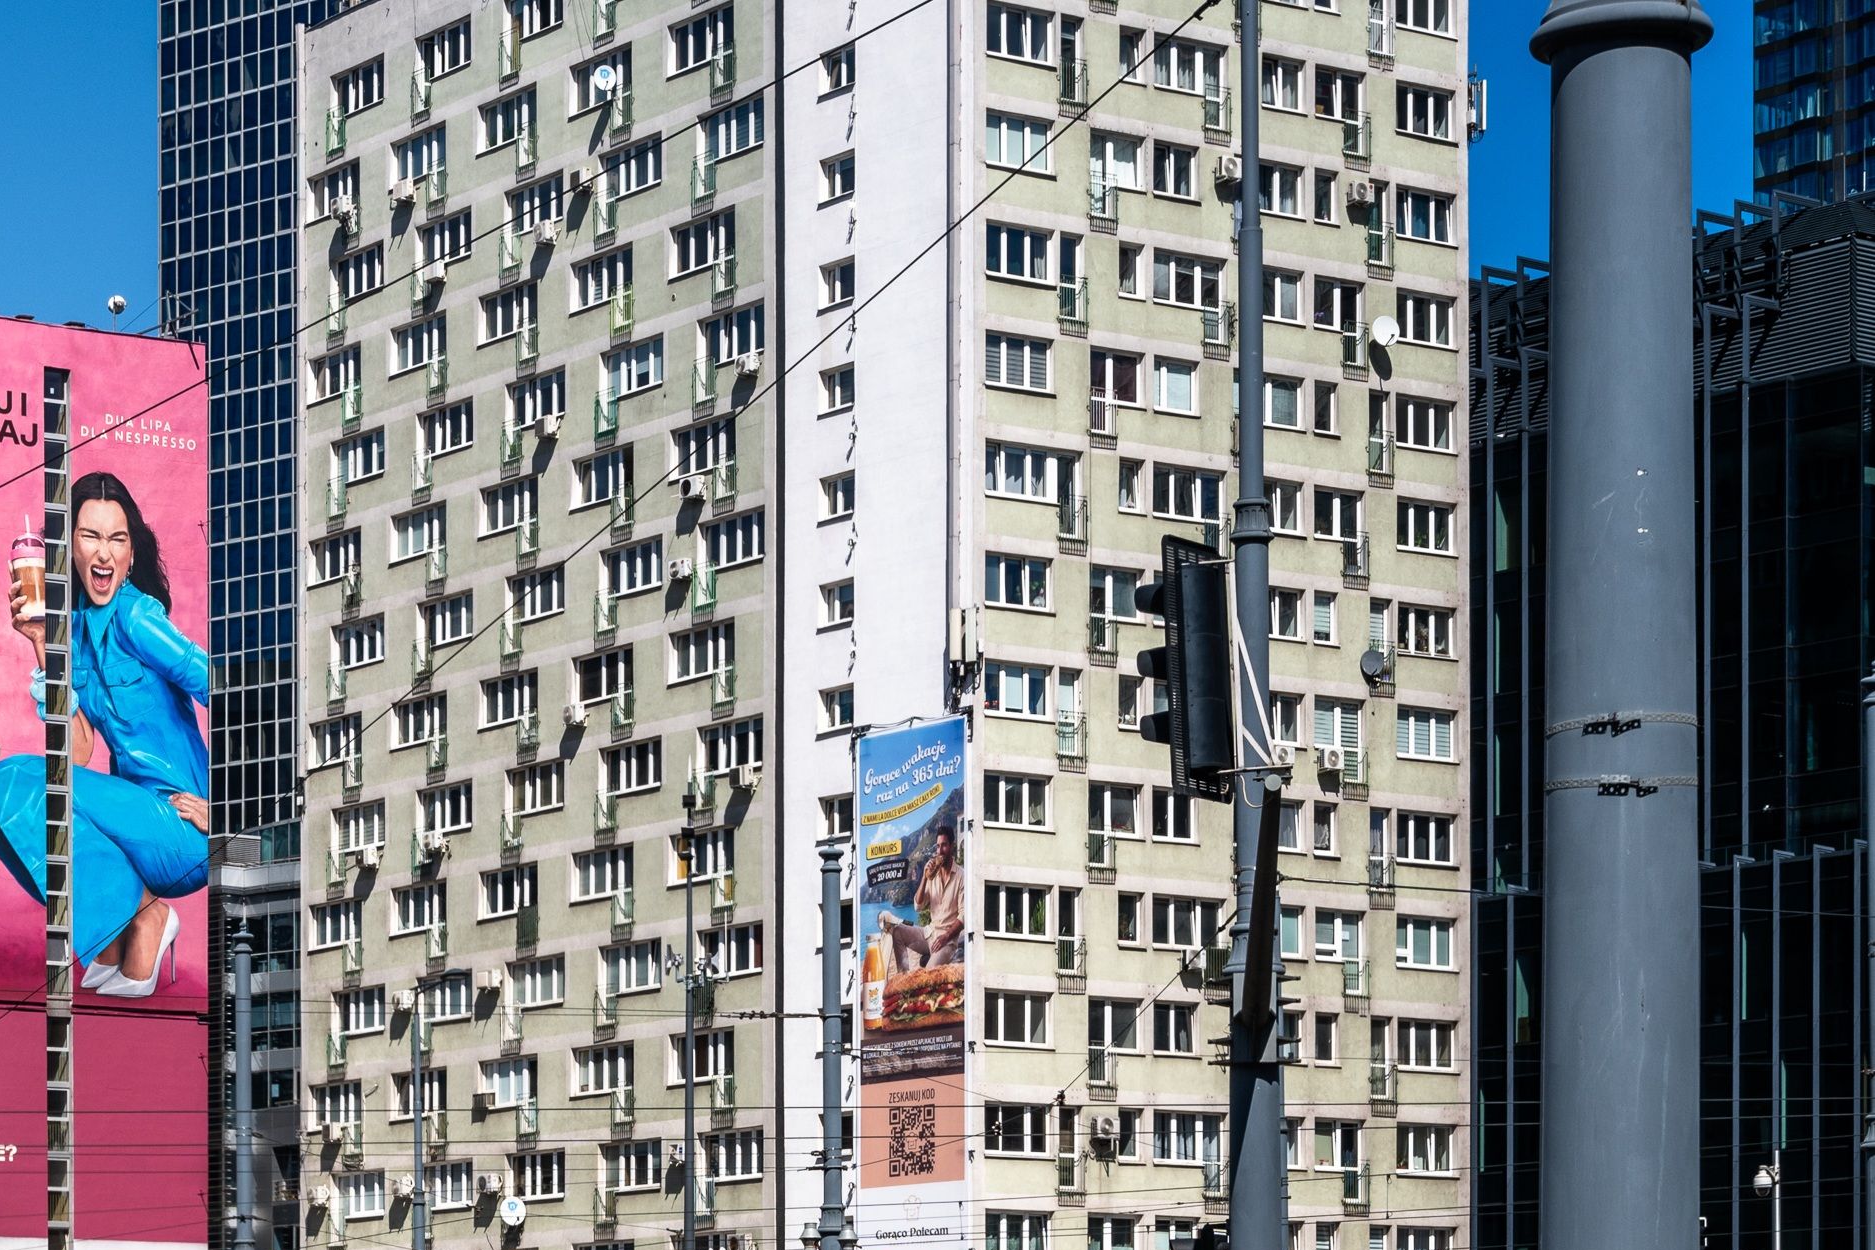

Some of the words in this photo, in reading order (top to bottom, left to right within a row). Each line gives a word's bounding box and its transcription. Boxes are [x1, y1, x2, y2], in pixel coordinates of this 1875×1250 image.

[21, 393, 27, 416] I
[105, 414, 135, 429] DUA
[141, 417, 172, 433] LIPA
[80, 426, 107, 440] DLA
[115, 430, 197, 451] NESPRESSO
[864, 766, 900, 795] Gorące
[902, 740, 946, 774] wakacje
[875, 790, 894, 804] raz
[895, 781, 909, 798] na
[912, 764, 933, 787] 365
[936, 755, 961, 777] dni?
[870, 842, 898, 856] KONKURS
[877, 872, 885, 882] 20
[885, 870, 897, 880] 000
[889, 1089, 921, 1104] ZESKANUJ
[922, 1088, 935, 1101] KOD
[875, 1229, 908, 1240] Gorąco
[910, 1226, 949, 1238] Polecam
